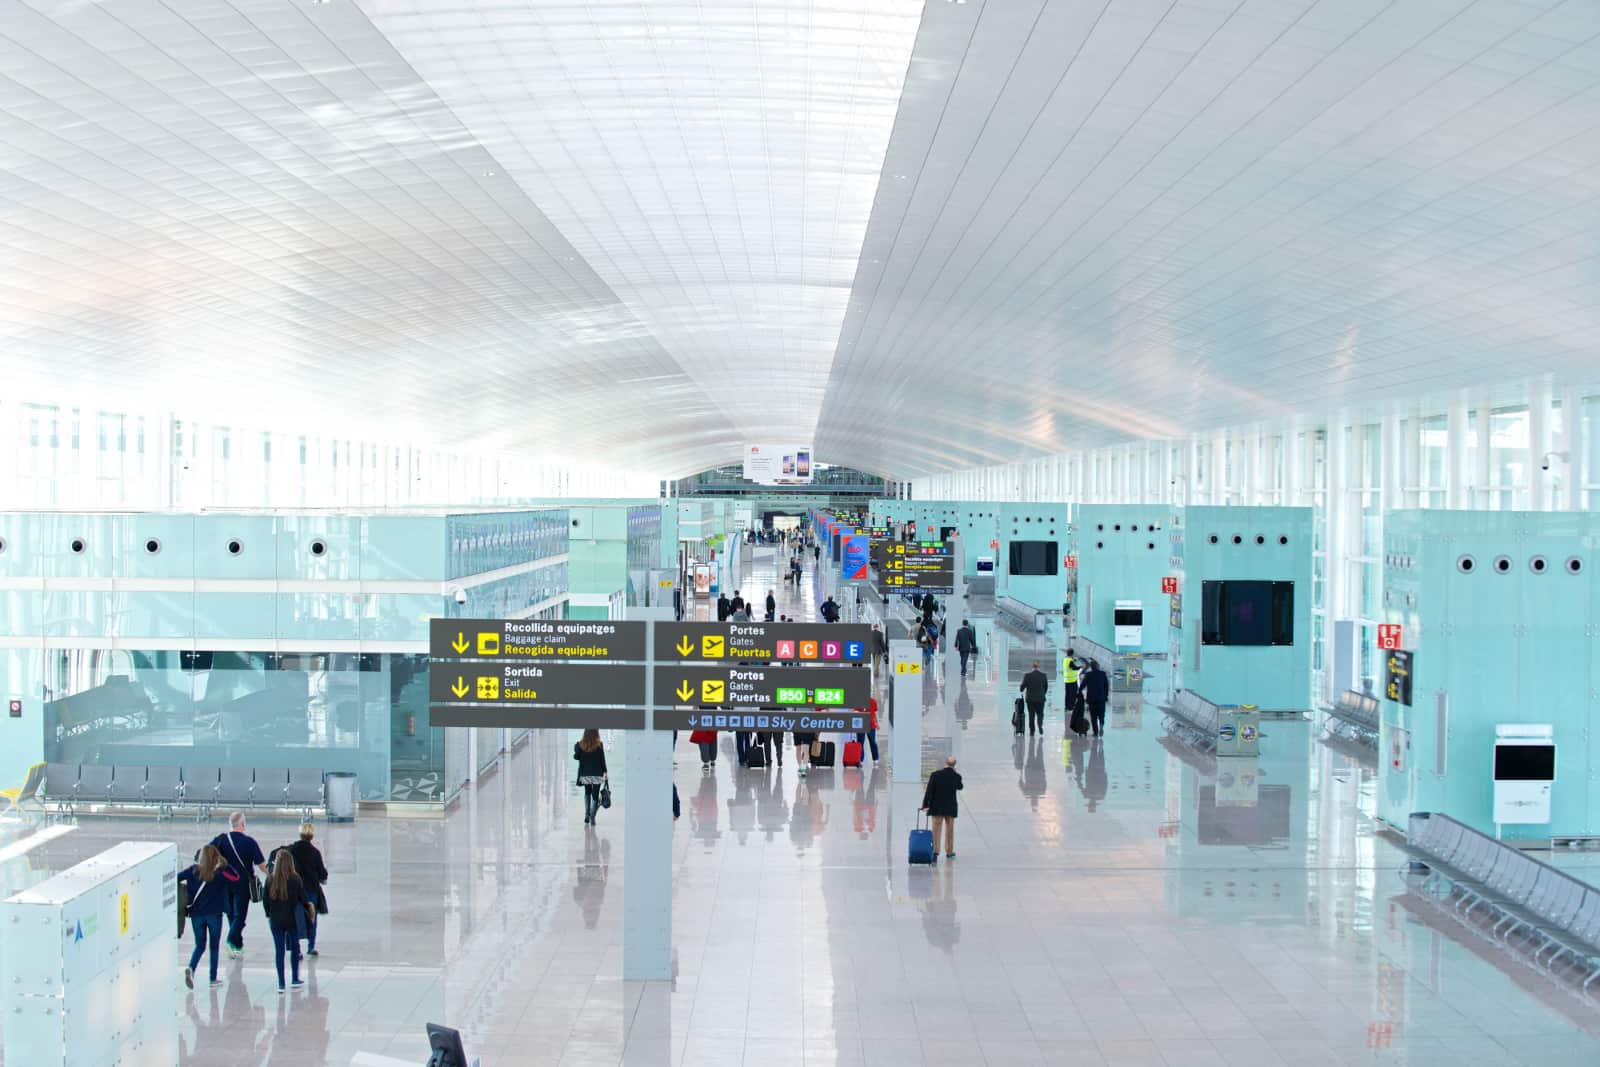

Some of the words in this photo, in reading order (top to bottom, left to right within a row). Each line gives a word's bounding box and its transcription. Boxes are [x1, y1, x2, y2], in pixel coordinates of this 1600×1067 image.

[505, 623, 553, 633] Recollida
[557, 624, 615, 635] equipatges
[730, 625, 764, 635] Portes
[505, 634, 541, 644] Baggage
[544, 635, 566, 643] claim
[730, 637, 754, 645] Gates
[505, 646, 553, 655] Recogida
[558, 646, 608, 656] equipajes
[730, 648, 770, 657] Puertas
[781, 644, 790, 655] A
[804, 644, 813, 655] C
[827, 644, 836, 655] D
[850, 645, 857, 656] E
[505, 667, 543, 677] Sortida
[730, 670, 764, 680] Portes
[505, 678, 520, 687] Exit
[730, 682, 753, 690] Gates
[505, 689, 537, 699] Salida
[730, 692, 770, 702] Puertas
[780, 690, 802, 701] B50
[818, 691, 840, 701] B24
[772, 716, 795, 730] Sky
[800, 717, 844, 728] Centre
